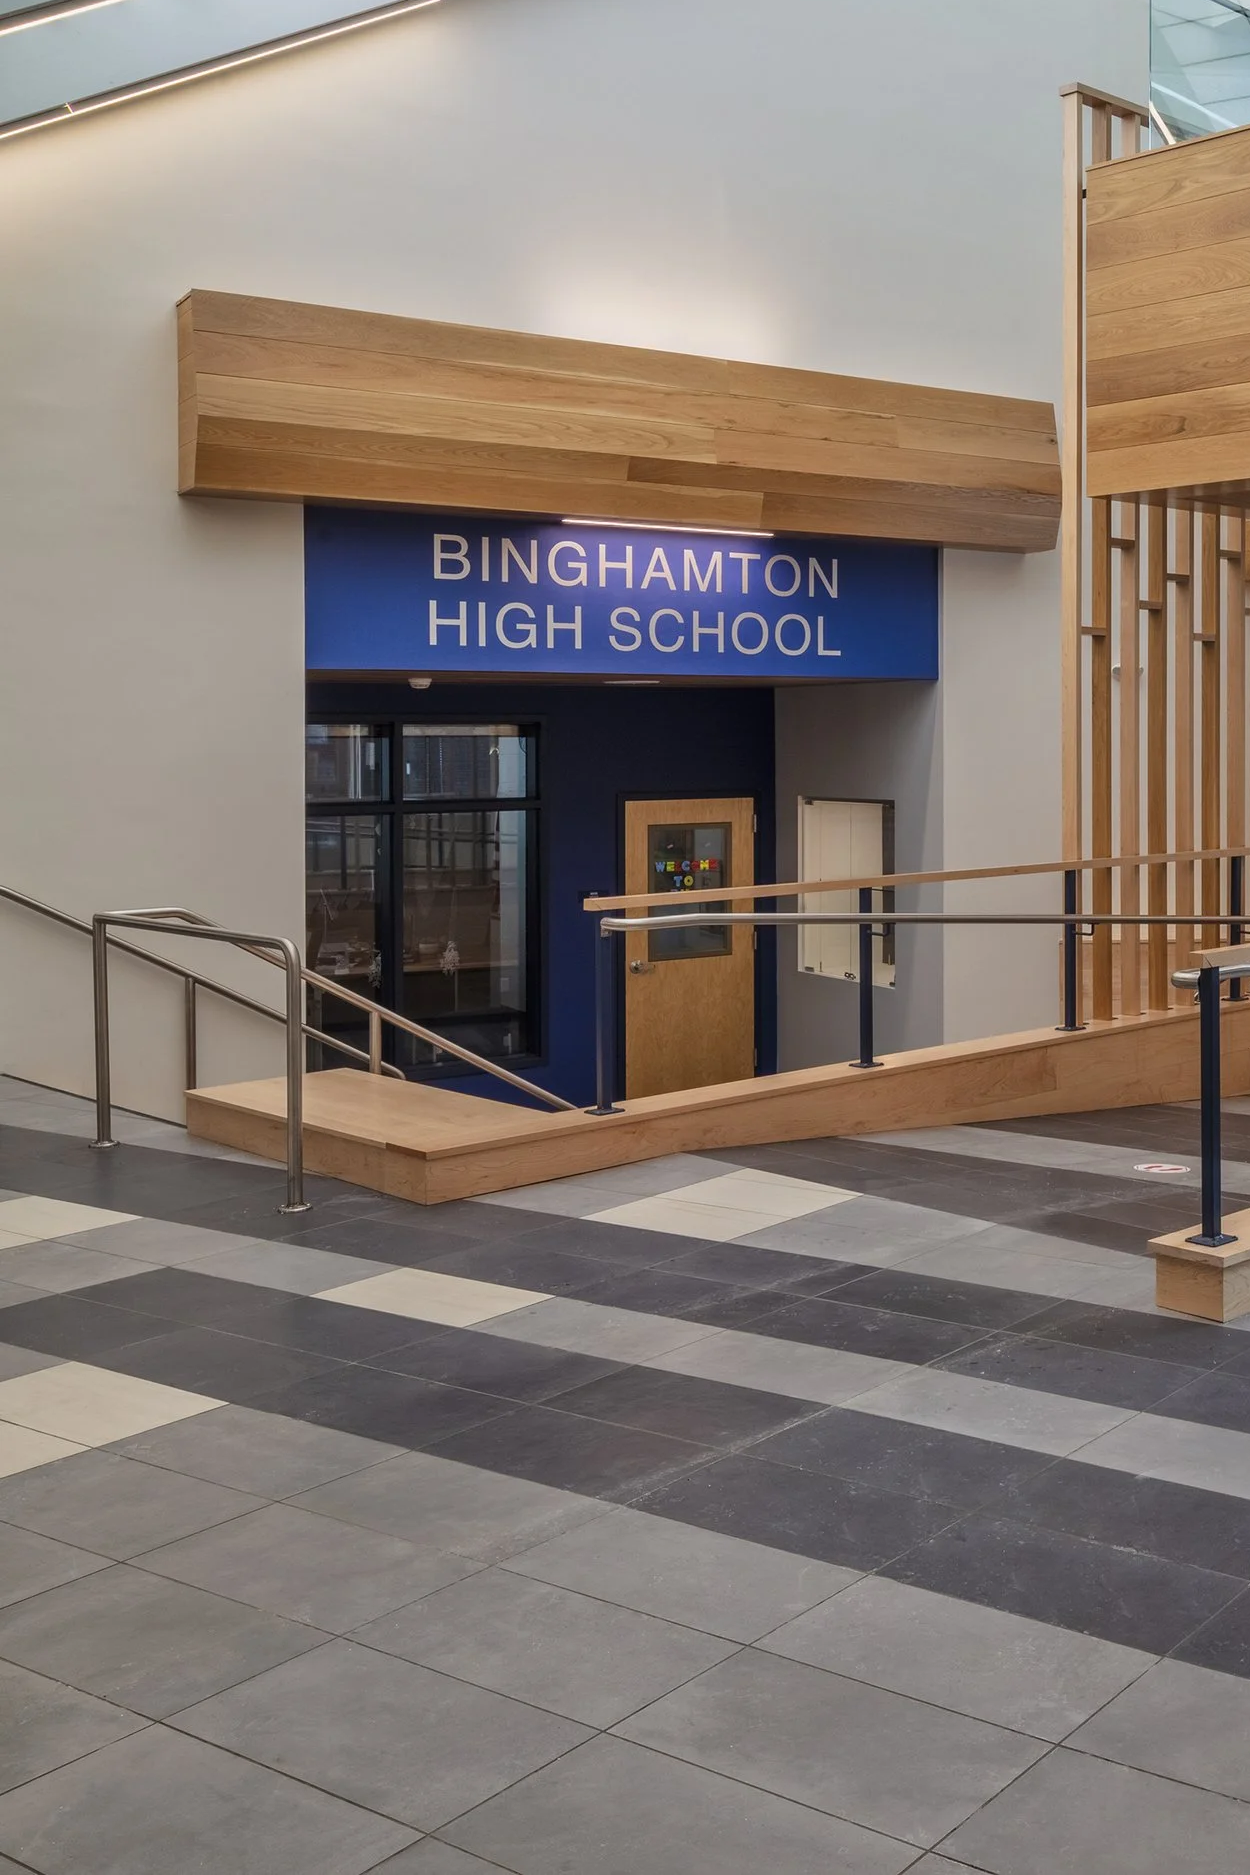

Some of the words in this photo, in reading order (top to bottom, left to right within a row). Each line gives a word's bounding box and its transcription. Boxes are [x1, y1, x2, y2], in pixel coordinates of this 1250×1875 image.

[432, 532, 840, 600] BINGHAMTON
[428, 600, 583, 650] HIGH
[608, 606, 842, 657] SCHOOL
[655, 858, 720, 873] WELCOME
[673, 875, 694, 887] TO
